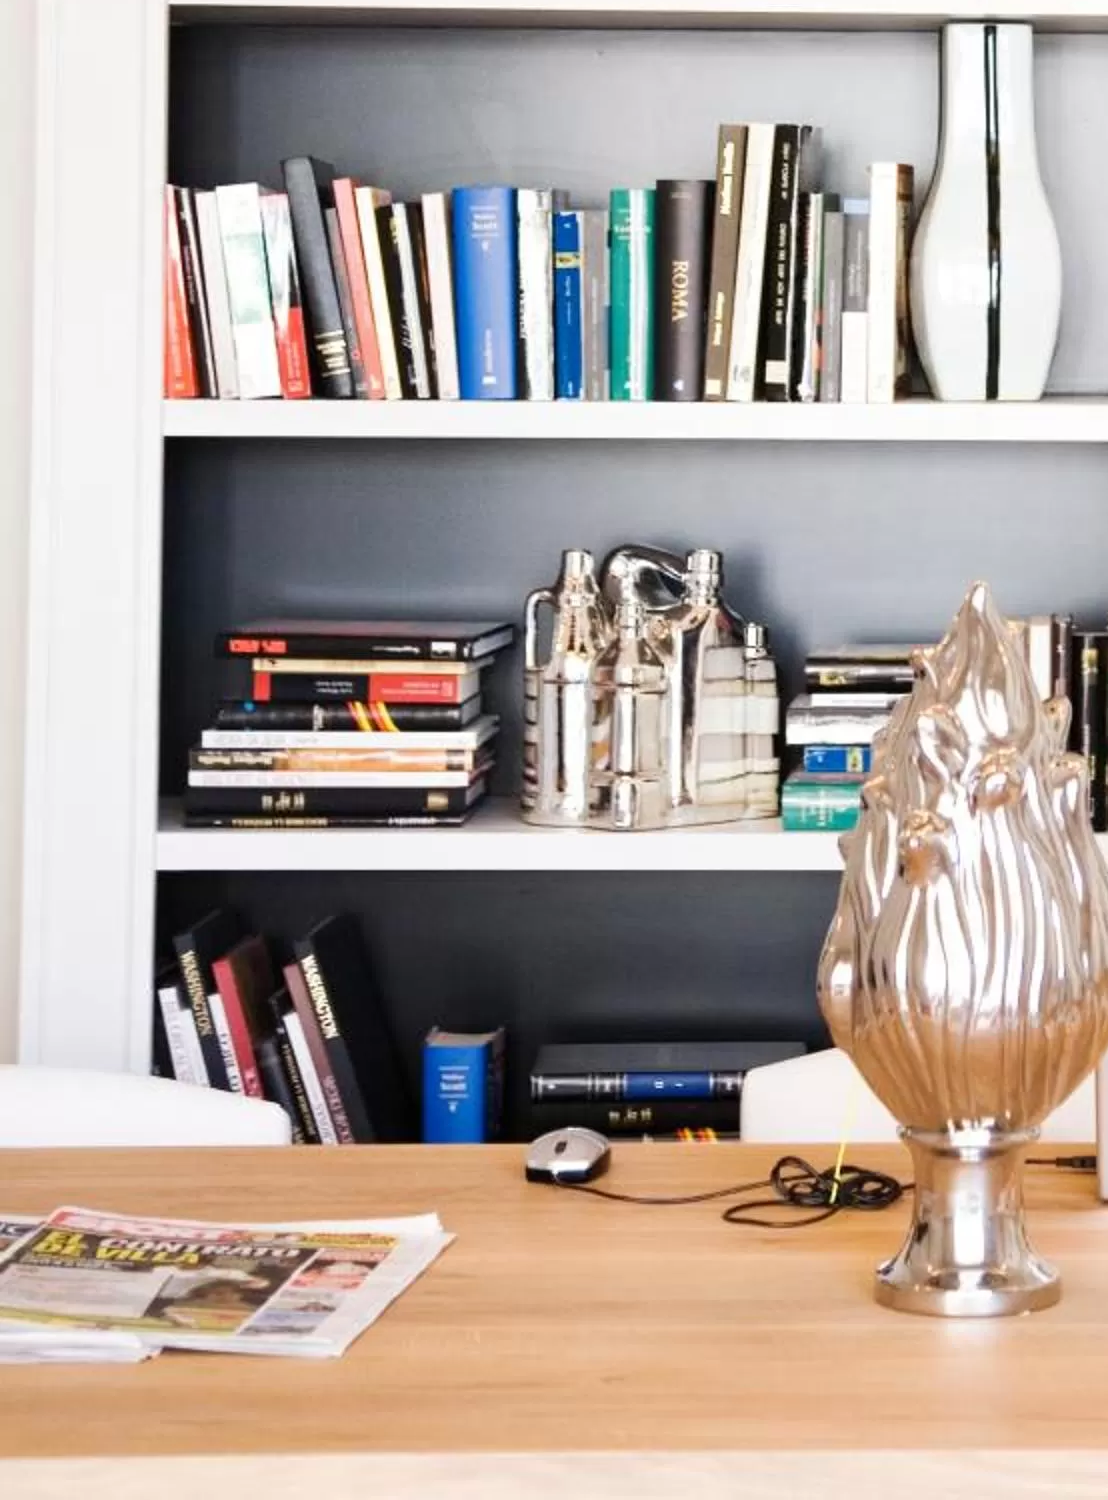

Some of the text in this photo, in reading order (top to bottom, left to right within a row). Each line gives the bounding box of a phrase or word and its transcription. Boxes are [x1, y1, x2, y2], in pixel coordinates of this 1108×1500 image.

[672, 260, 689, 322] ROMA
[175, 949, 217, 1037] WASHINGTON
[299, 953, 340, 1040] WASHINGTON
[32, 1243, 200, 1264] DE VILLA
[43, 1231, 301, 1257] EL CONTRATO
